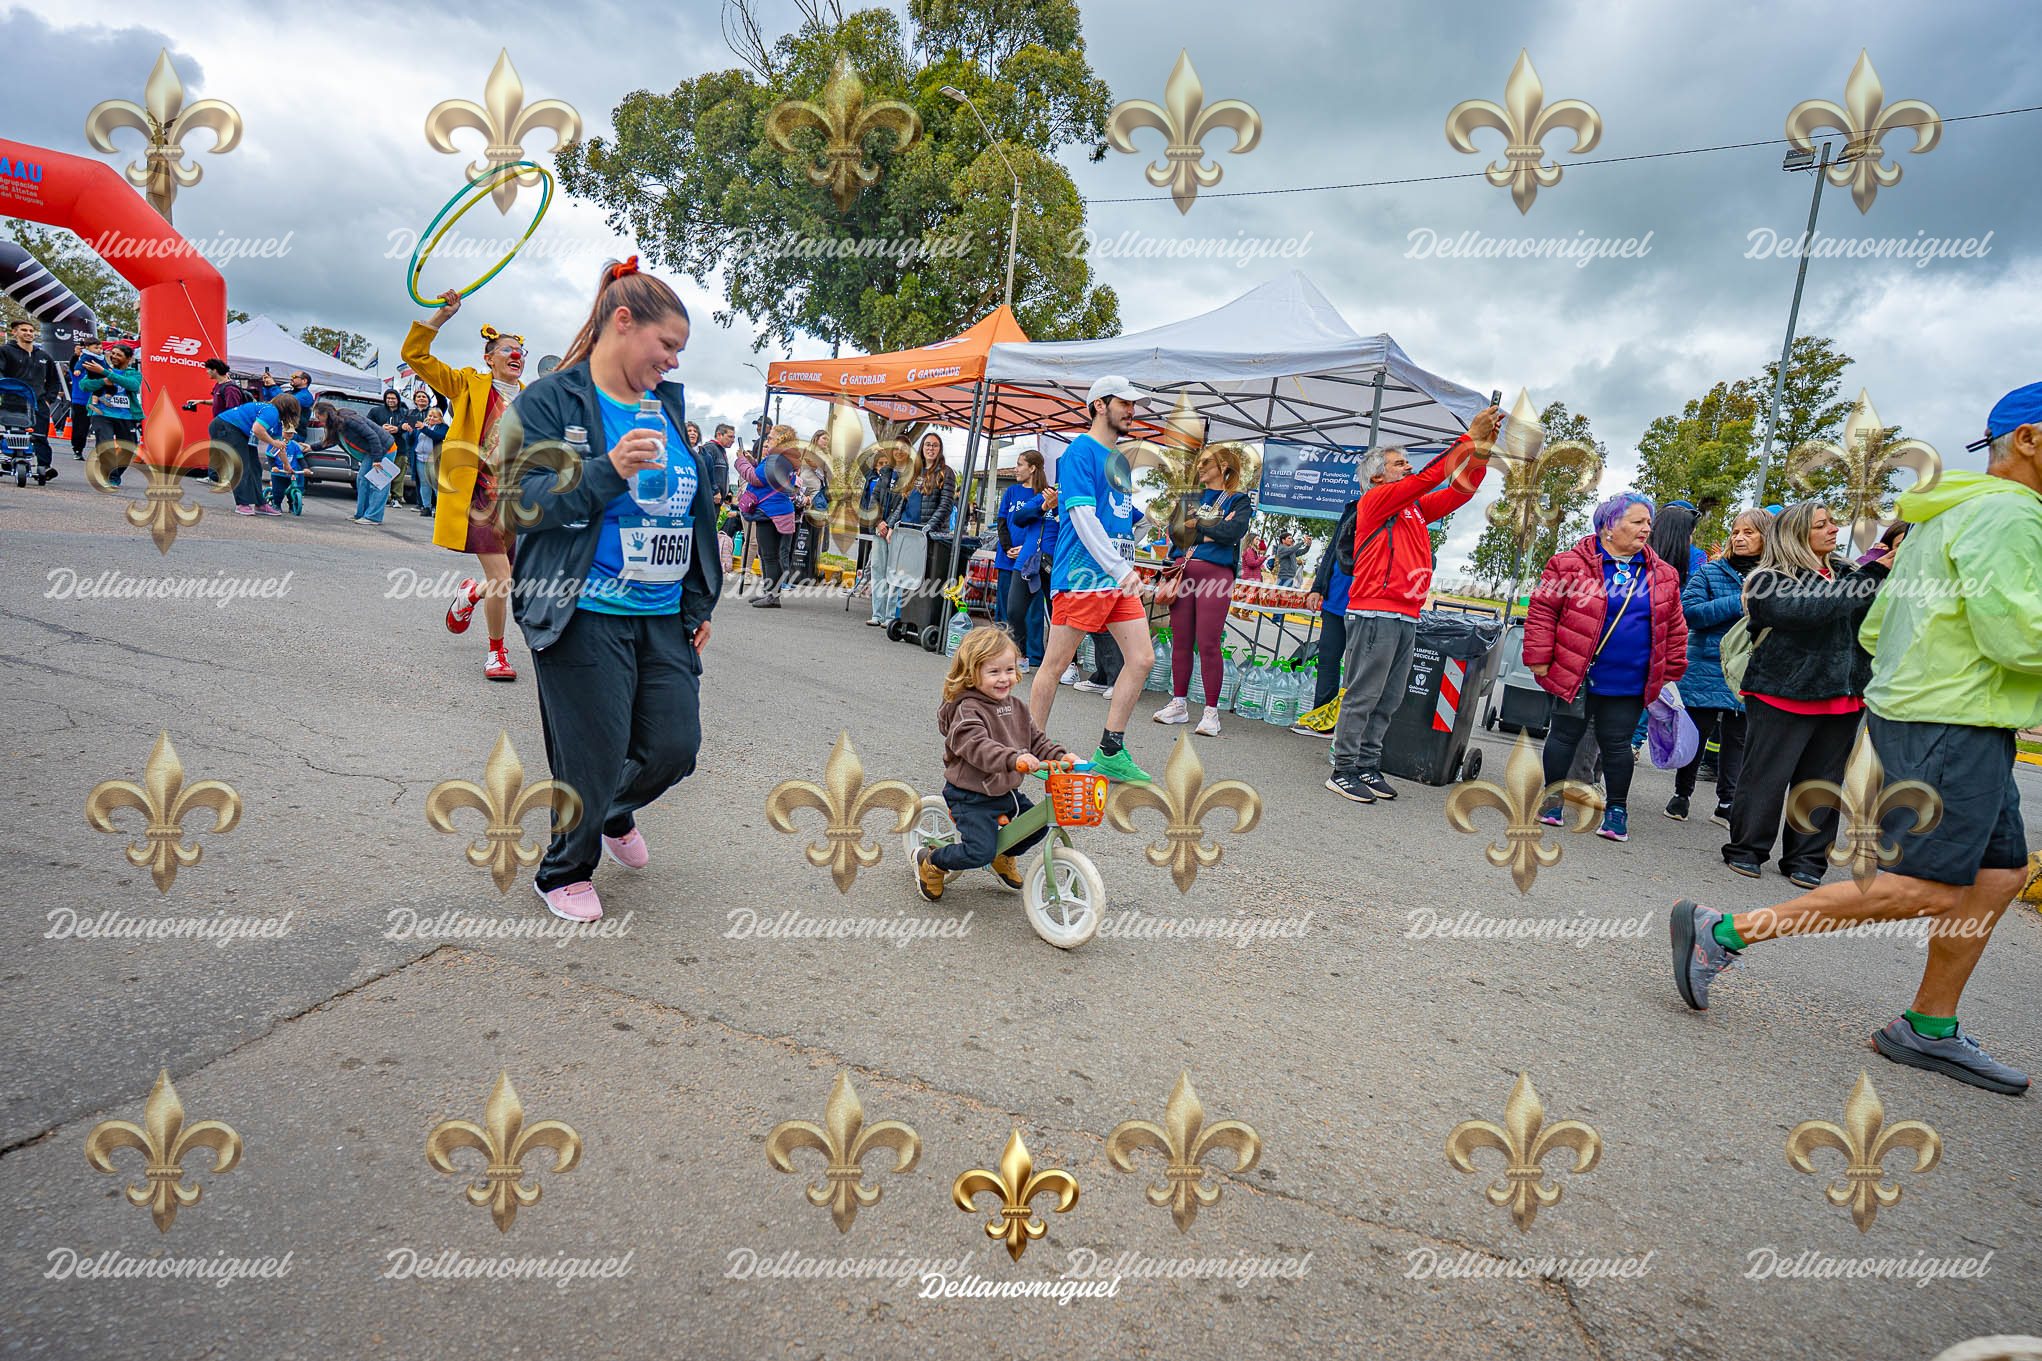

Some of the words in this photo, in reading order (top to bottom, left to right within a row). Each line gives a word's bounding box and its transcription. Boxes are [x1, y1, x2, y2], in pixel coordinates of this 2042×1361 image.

[170, 355, 207, 369] balanc
[788, 371, 823, 382] GATORADE
[849, 373, 887, 385] GATORADE
[917, 366, 961, 380] GATORADE
[650, 534, 690, 566] 16660
